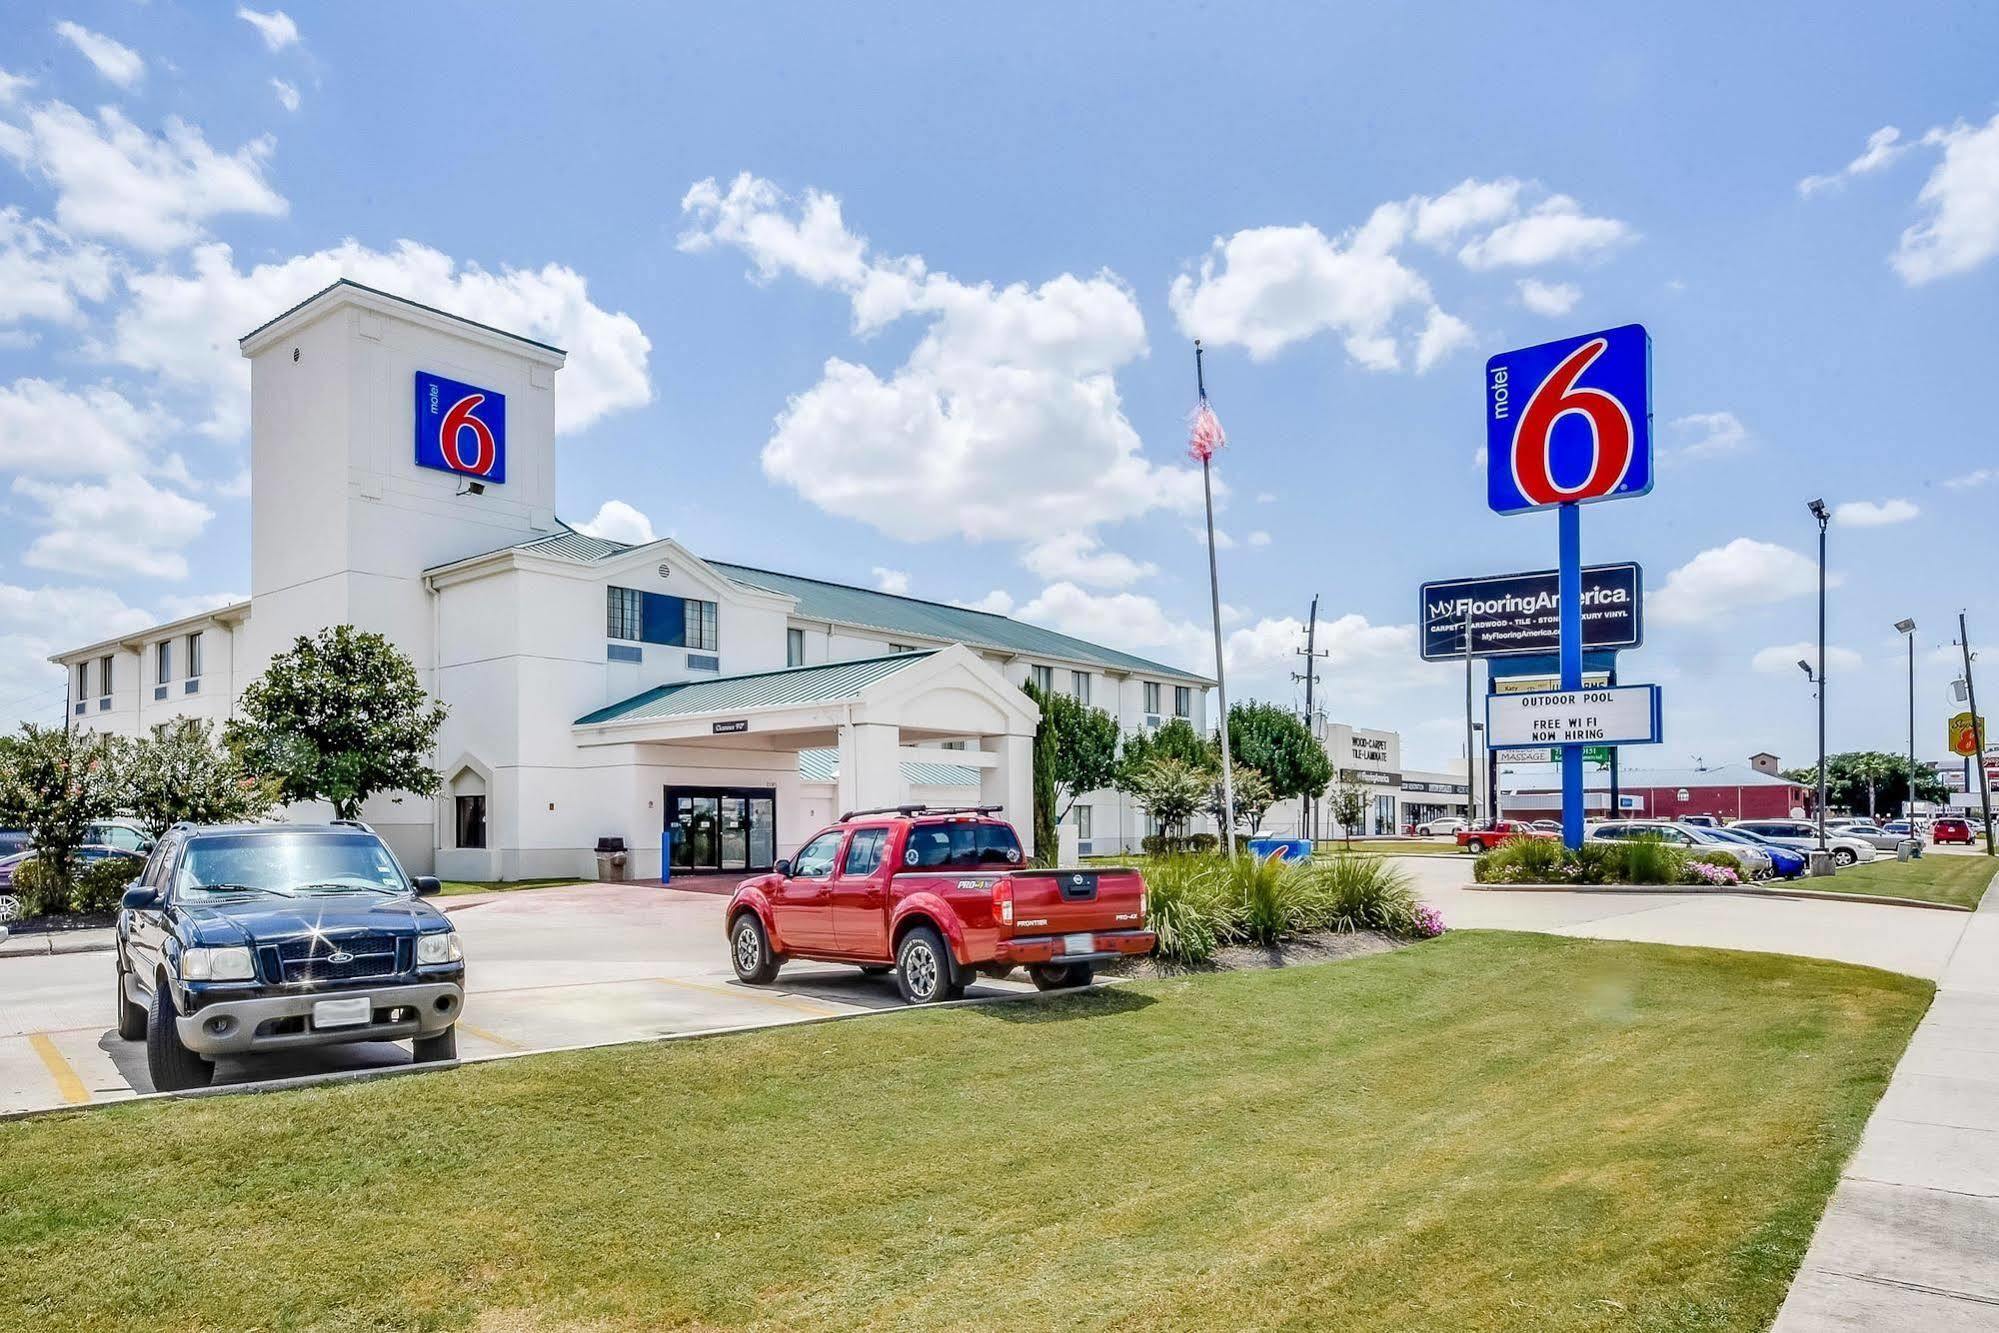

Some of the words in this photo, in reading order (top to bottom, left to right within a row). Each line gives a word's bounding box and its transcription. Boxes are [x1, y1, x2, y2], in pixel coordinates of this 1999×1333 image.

[1490, 366, 1509, 419] motel
[1511, 337, 1634, 505] 6
[429, 384, 438, 414] motel
[440, 393, 495, 475] 6
[1431, 624, 1458, 632] CARPET
[1470, 620, 1508, 629] ARDWOOD
[1514, 617, 1531, 626] TILE
[1538, 616, 1559, 624] STON
[1581, 612, 1602, 620] XURY
[1604, 610, 1628, 618] VINYL
[1522, 694, 1575, 707] OUTDOOR
[1584, 692, 1614, 703] POOL
[1533, 719, 1561, 730] FREE
[1532, 732, 1556, 742] NOW
[1564, 729, 1604, 741] HIRING
[1501, 752, 1545, 761] MASSAGE
[1017, 919, 1048, 927] FRONTIER
[1115, 913, 1137, 921] PRO-4X
